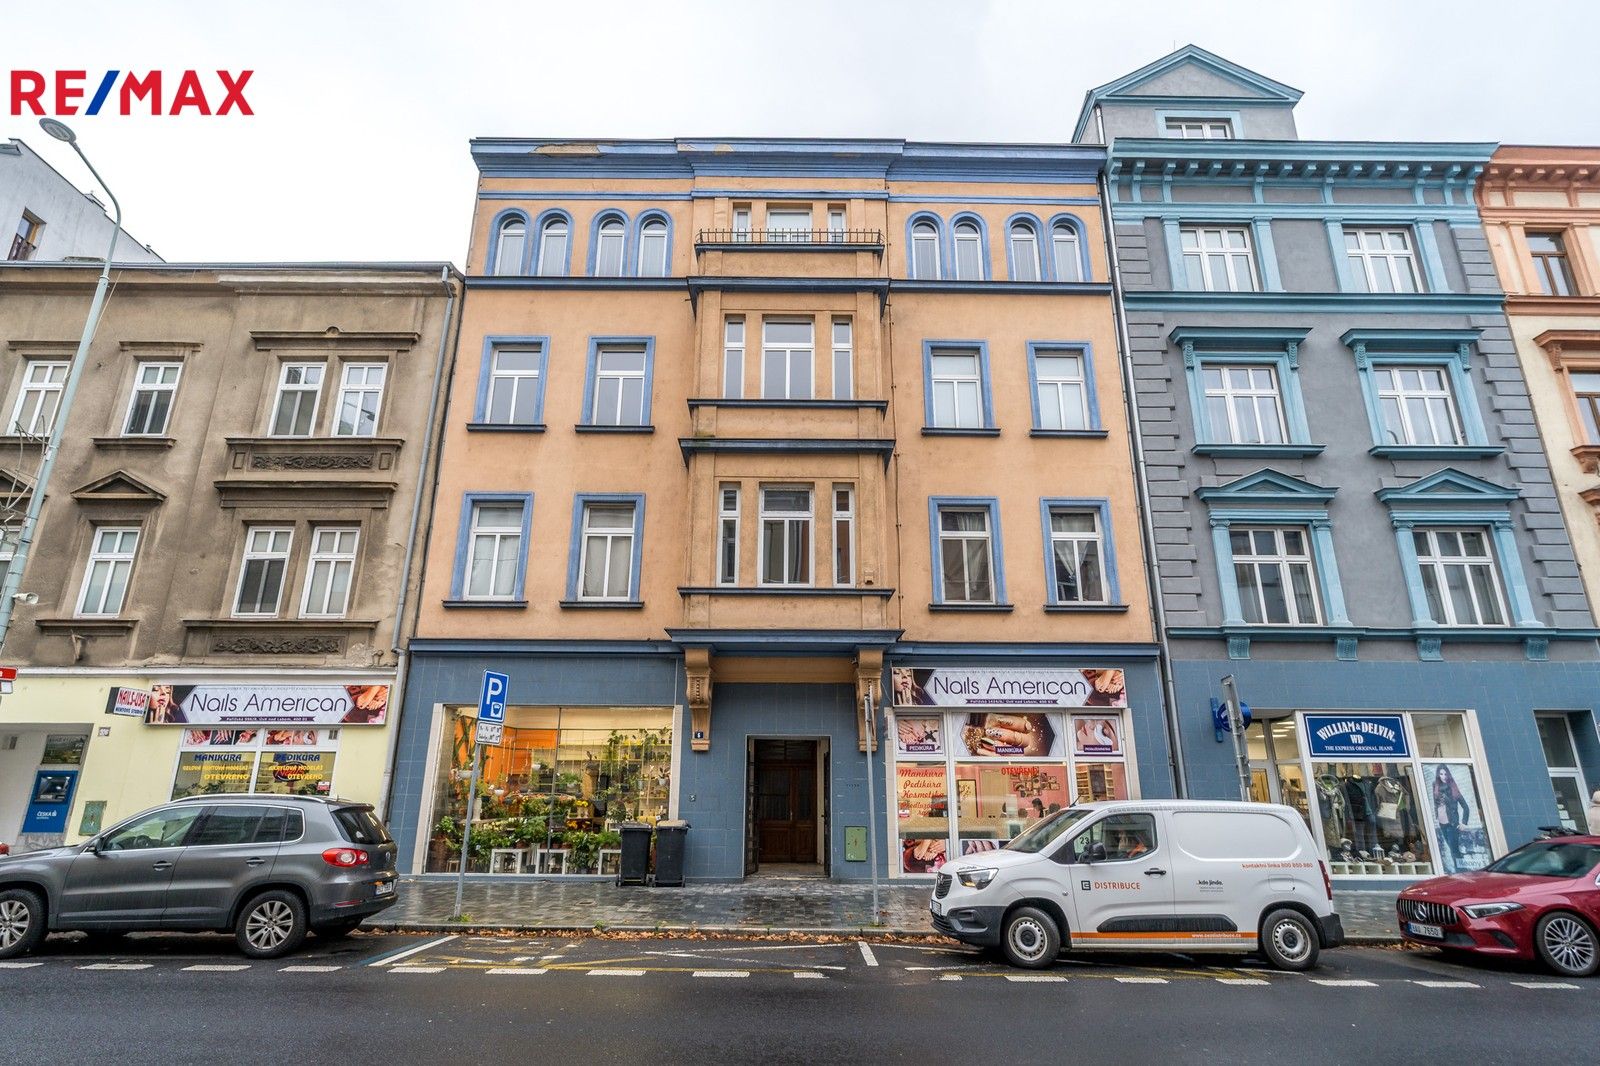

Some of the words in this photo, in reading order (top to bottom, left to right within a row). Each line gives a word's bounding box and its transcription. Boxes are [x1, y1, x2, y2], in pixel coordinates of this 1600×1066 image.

[486, 678, 503, 704] P
[933, 677, 979, 695] Nails
[986, 676, 1086, 695] American
[190, 693, 237, 712] Nails
[243, 693, 347, 712] American
[1317, 721, 1355, 741] WILLIAM
[1361, 721, 1395, 741] DELVIN
[1350, 734, 1364, 744] WD
[1094, 881, 1140, 890] DISTRIBUCE
